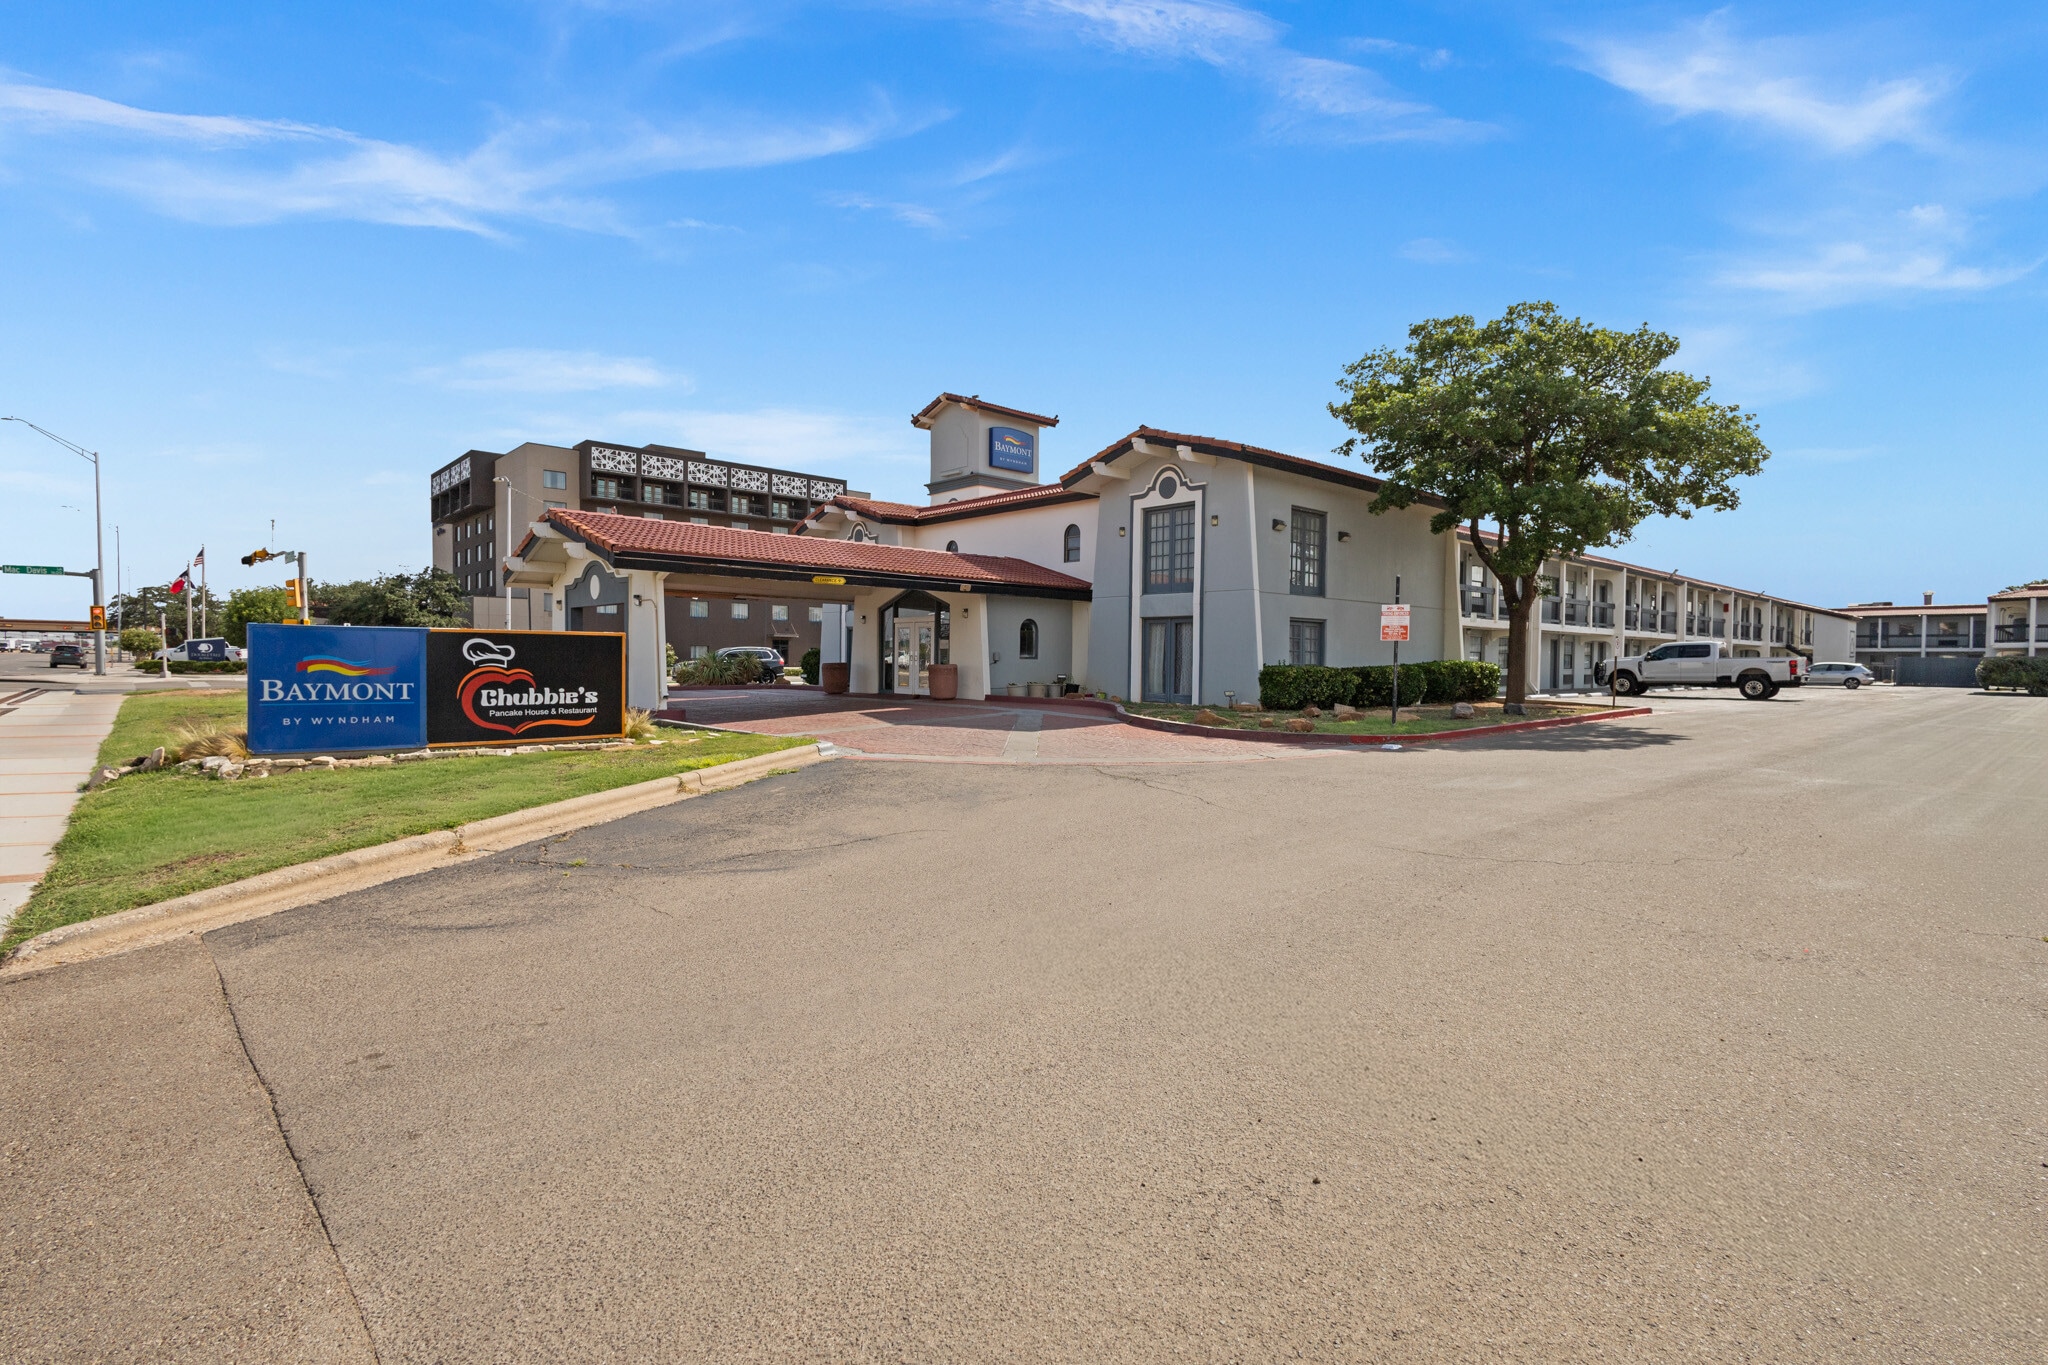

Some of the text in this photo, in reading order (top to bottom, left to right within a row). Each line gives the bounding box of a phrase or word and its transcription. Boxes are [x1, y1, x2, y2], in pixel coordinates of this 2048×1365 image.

[995, 441, 1032, 457] BAYMONT
[4, 565, 20, 574] Mac
[26, 566, 47, 575] Davis
[259, 679, 415, 702] BAYMONT
[480, 686, 599, 707] Chubbie's
[489, 709, 523, 717] Pancake
[525, 708, 549, 716] House
[558, 706, 598, 715] Restaurant
[282, 715, 395, 726] BY WYNDHAM
